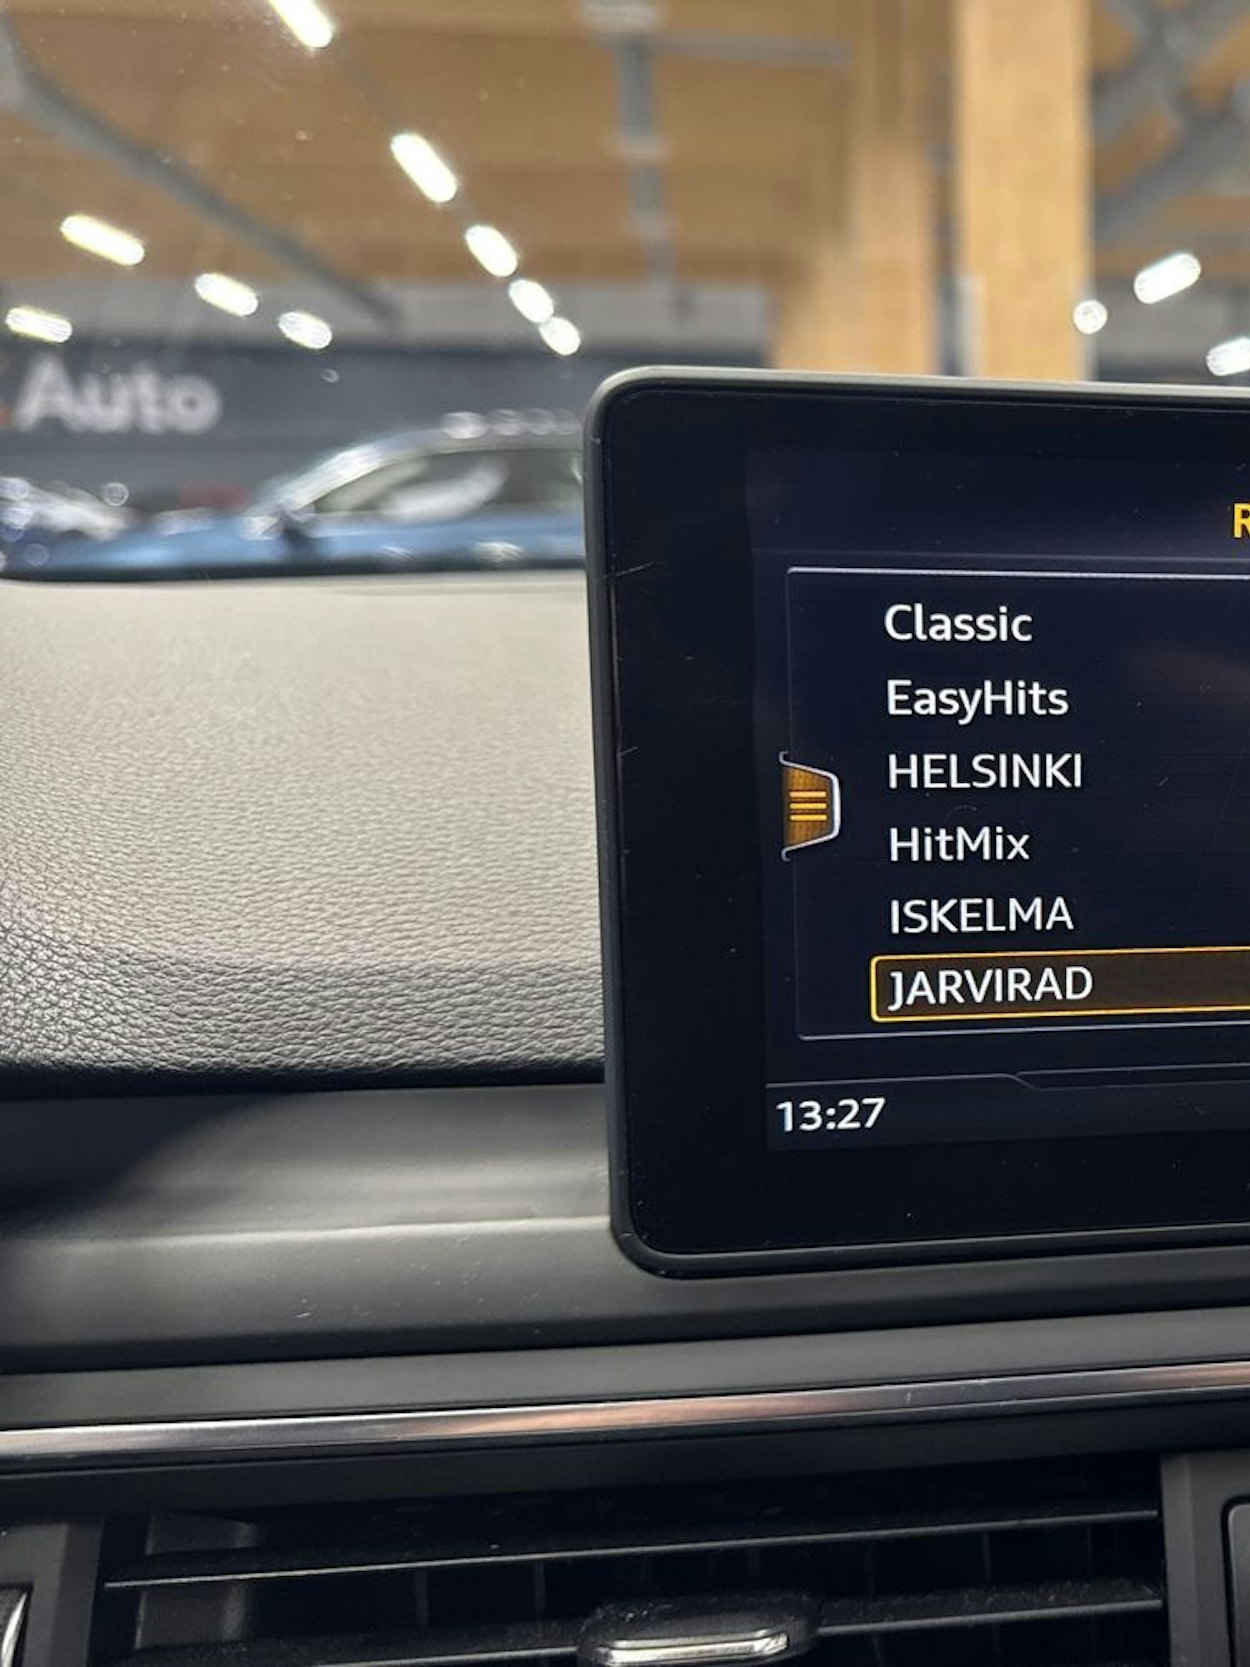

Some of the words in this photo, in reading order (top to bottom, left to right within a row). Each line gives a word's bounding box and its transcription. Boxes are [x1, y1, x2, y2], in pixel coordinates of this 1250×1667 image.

[16, 352, 222, 434] Auto
[884, 602, 1033, 642] Classic
[887, 679, 1069, 726] EasyHits
[888, 752, 1082, 789] HELSINKI
[890, 825, 1030, 862] HitMix
[890, 896, 1075, 934] ISKELMA
[887, 966, 1097, 1012] JARVIRAD
[776, 1097, 886, 1132] 13:27
